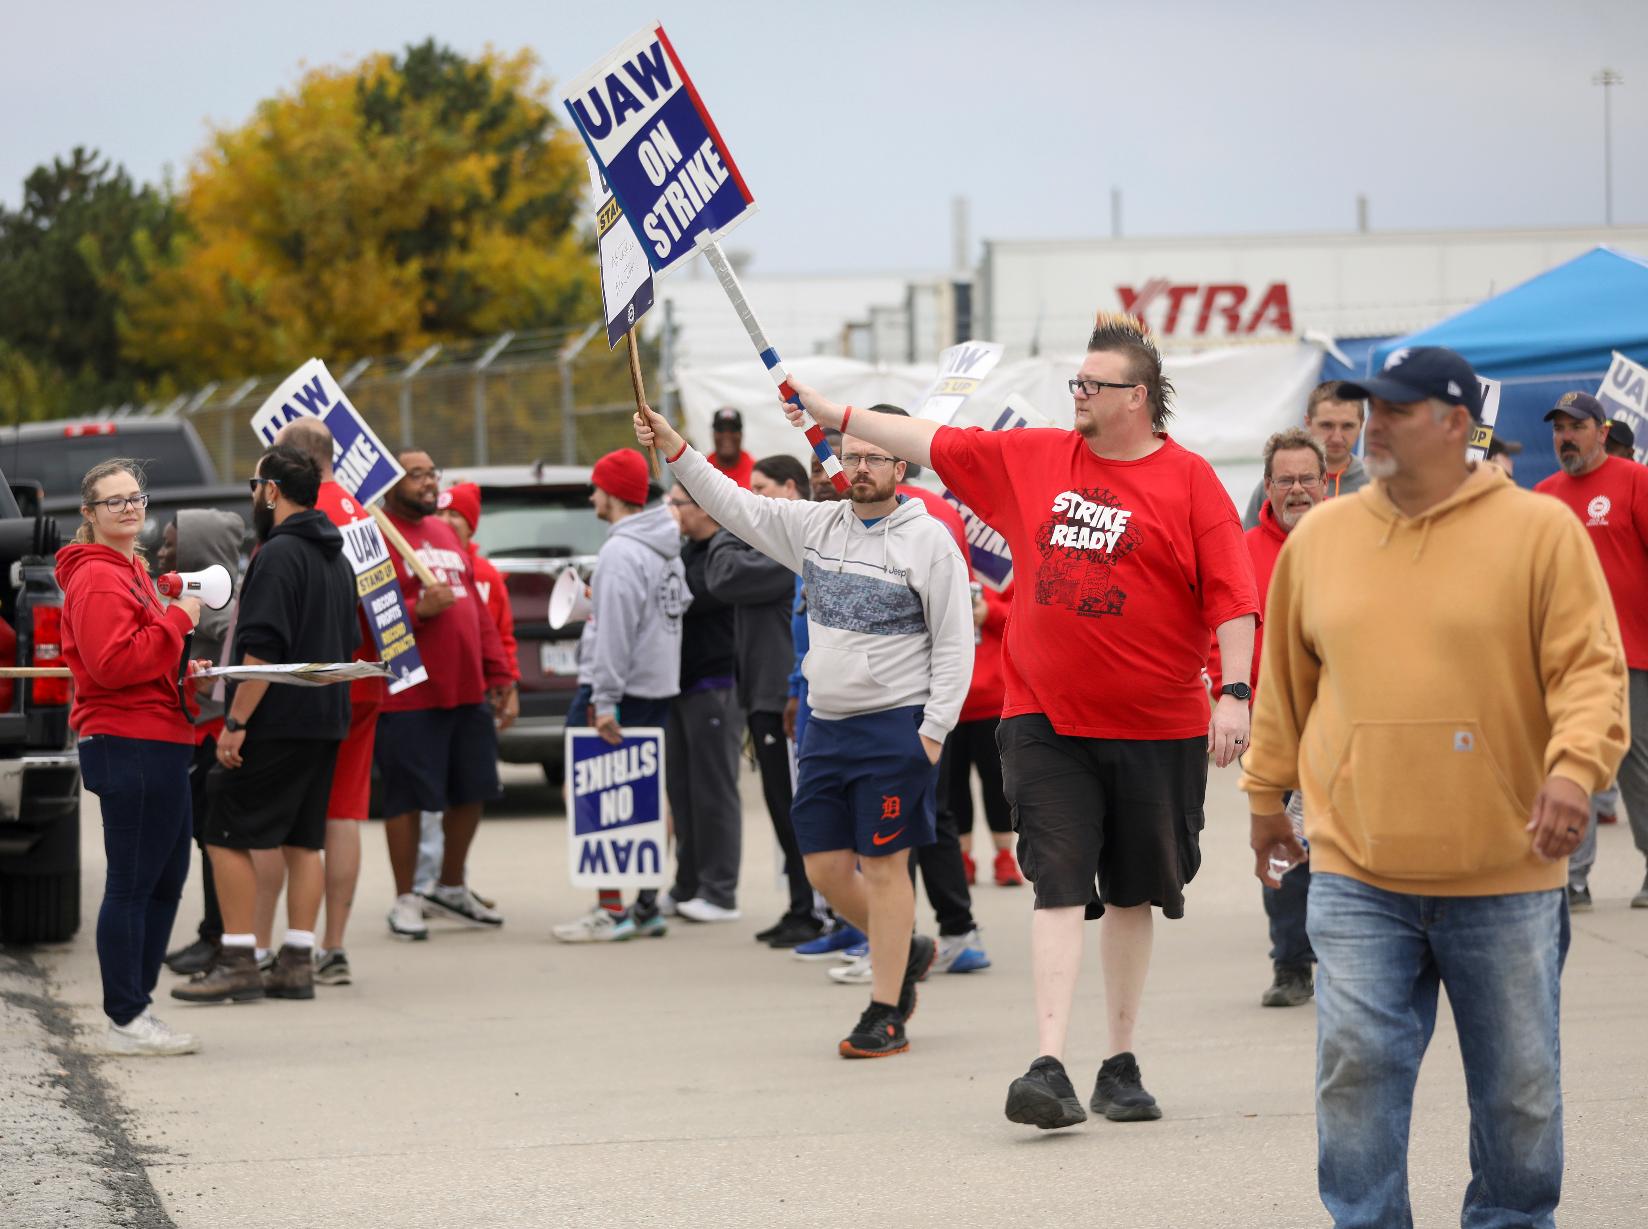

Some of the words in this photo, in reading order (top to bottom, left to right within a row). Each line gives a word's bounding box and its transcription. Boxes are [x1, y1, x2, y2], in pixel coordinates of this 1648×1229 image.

[573, 41, 673, 140] UAW
[638, 120, 682, 186] ON
[643, 137, 730, 259] STRIKE
[1115, 278, 1293, 335] XTRA
[1612, 360, 1648, 418] UA
[333, 432, 381, 497] RIKE
[1051, 491, 1132, 532] STRIKE
[347, 524, 383, 564] UAW
[1050, 524, 1122, 553] READY
[1090, 551, 1118, 566] 2023
[360, 567, 383, 592] STAND
[383, 563, 394, 581] UP
[889, 566, 907, 578] Jeep
[574, 741, 659, 797] STRIKE
[600, 785, 634, 826] ON
[579, 839, 662, 874] UAW
